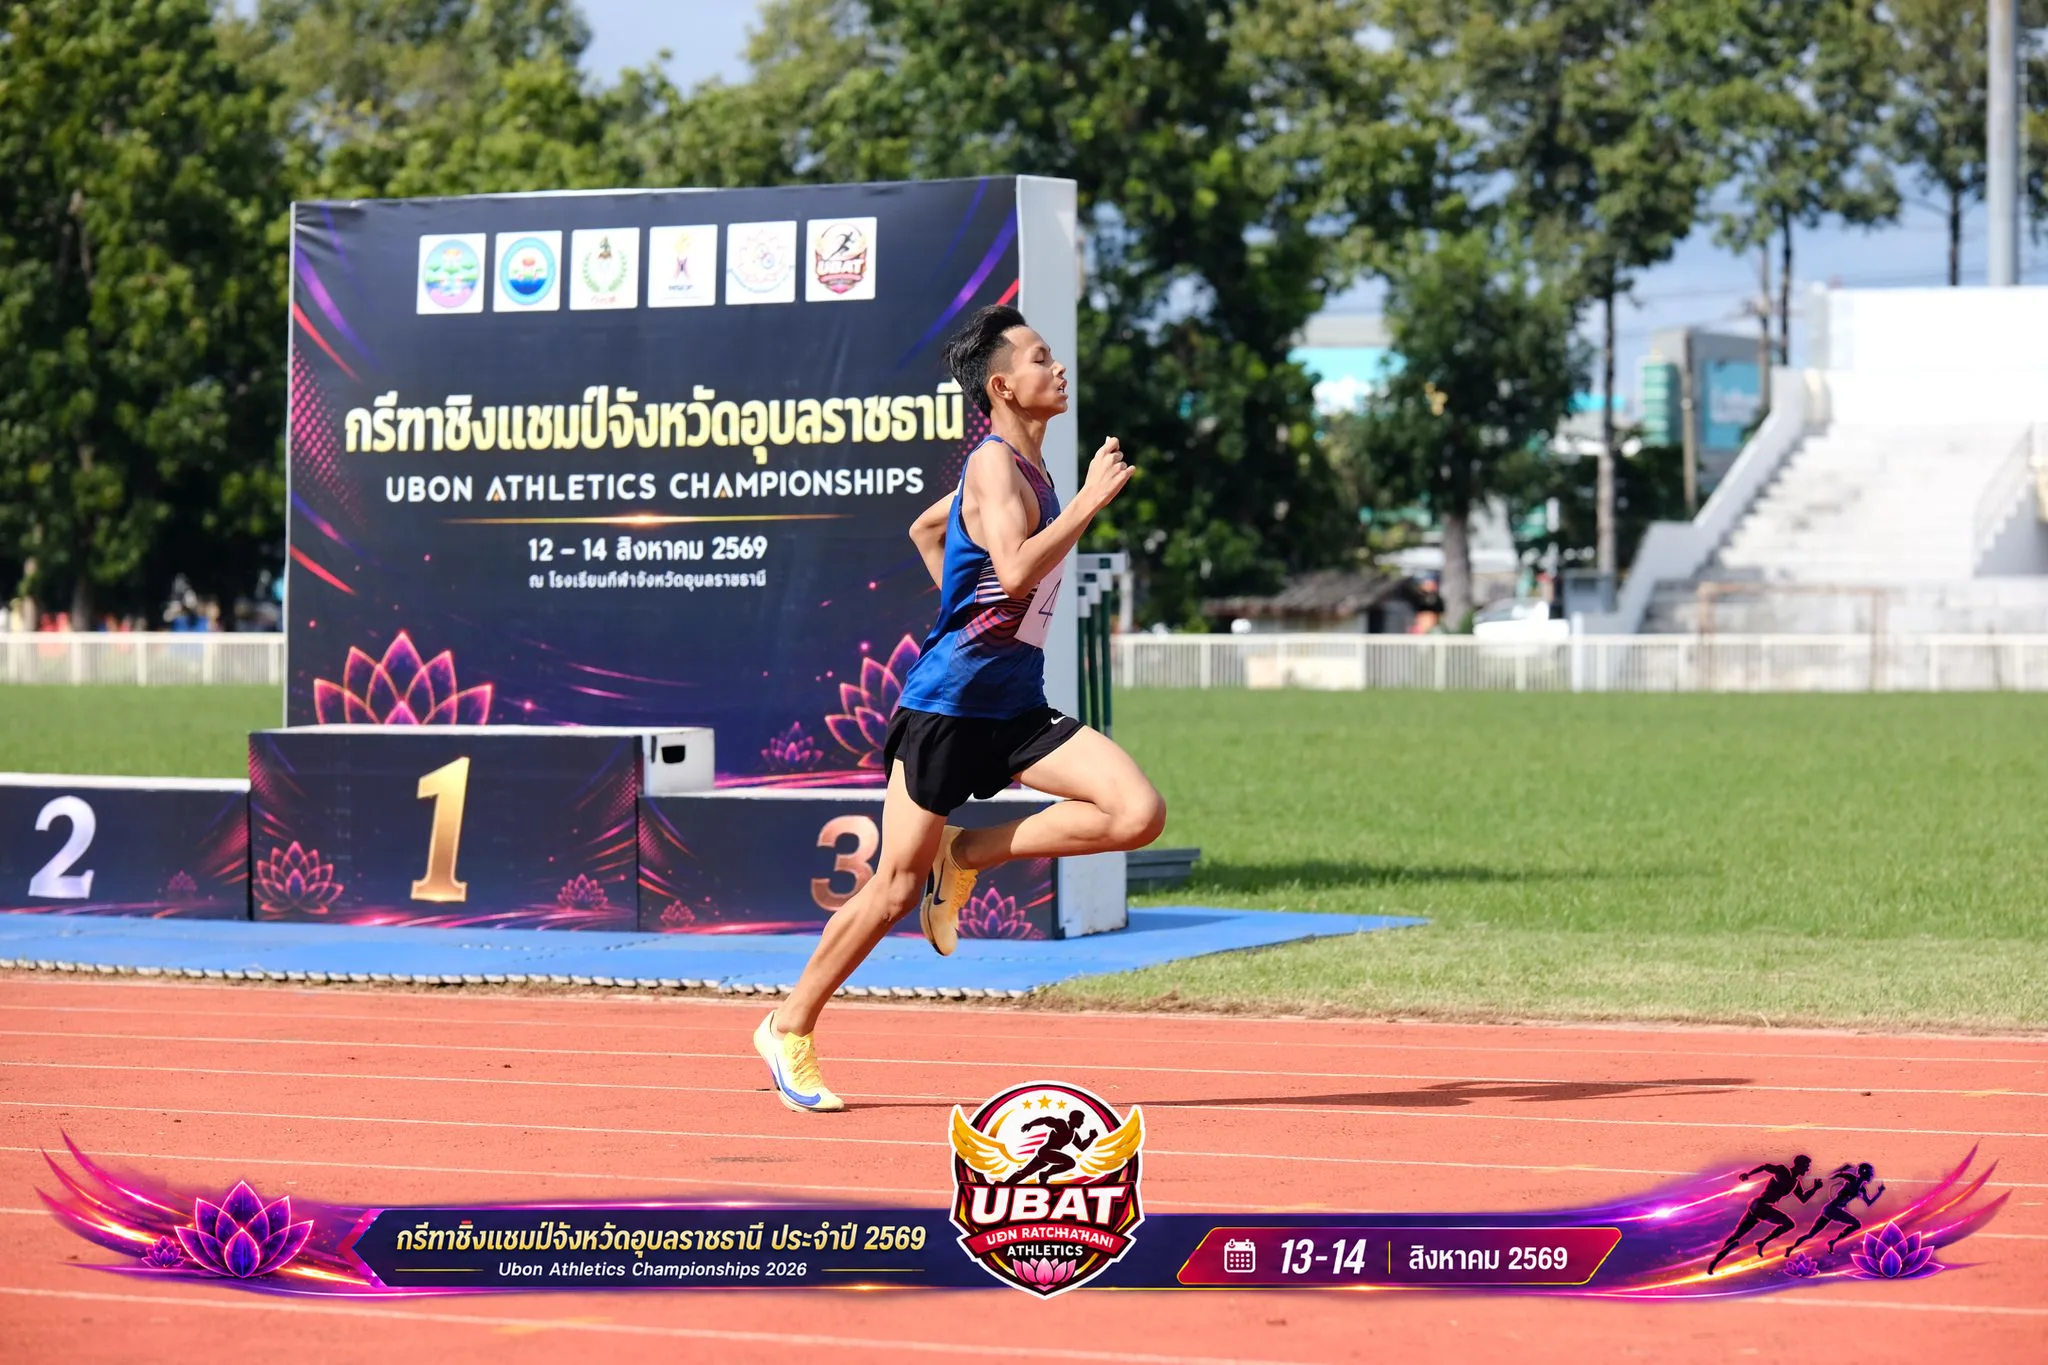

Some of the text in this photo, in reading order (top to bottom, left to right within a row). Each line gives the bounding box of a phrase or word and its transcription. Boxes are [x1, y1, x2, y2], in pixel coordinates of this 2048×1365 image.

[386, 467, 924, 502] UBON ATHLETICS CHAMPIONSHIPS
[528, 538, 553, 561] 12
[582, 538, 607, 561] 14
[616, 536, 704, 561] สิงหาคม
[712, 536, 768, 560] 2569
[529, 574, 544, 588] ณ
[28, 795, 96, 898] 2
[411, 756, 470, 902] 1
[811, 815, 879, 912] 3
